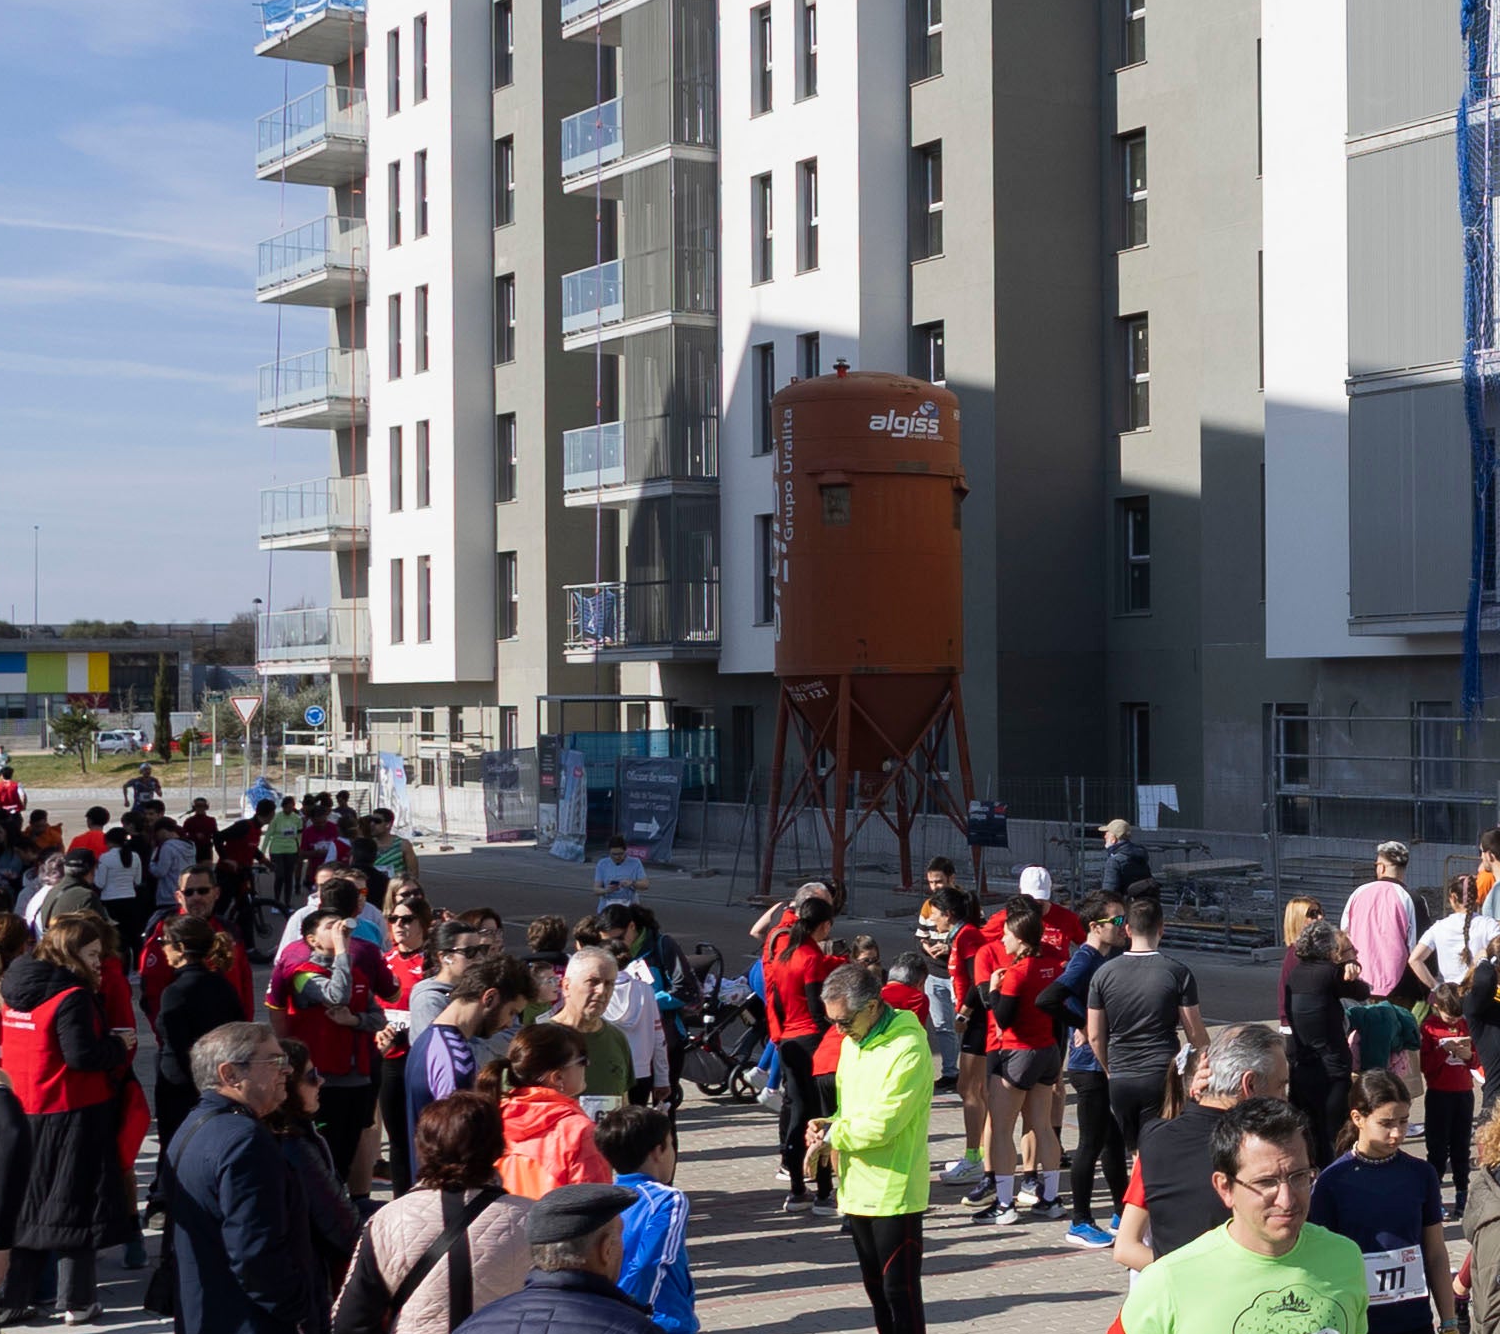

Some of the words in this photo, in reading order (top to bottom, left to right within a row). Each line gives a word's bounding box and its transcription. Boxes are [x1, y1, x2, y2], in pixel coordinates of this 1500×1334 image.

[782, 408, 793, 474] Uralita
[783, 480, 795, 542] Grupo
[1375, 1266, 1406, 1292] 777
